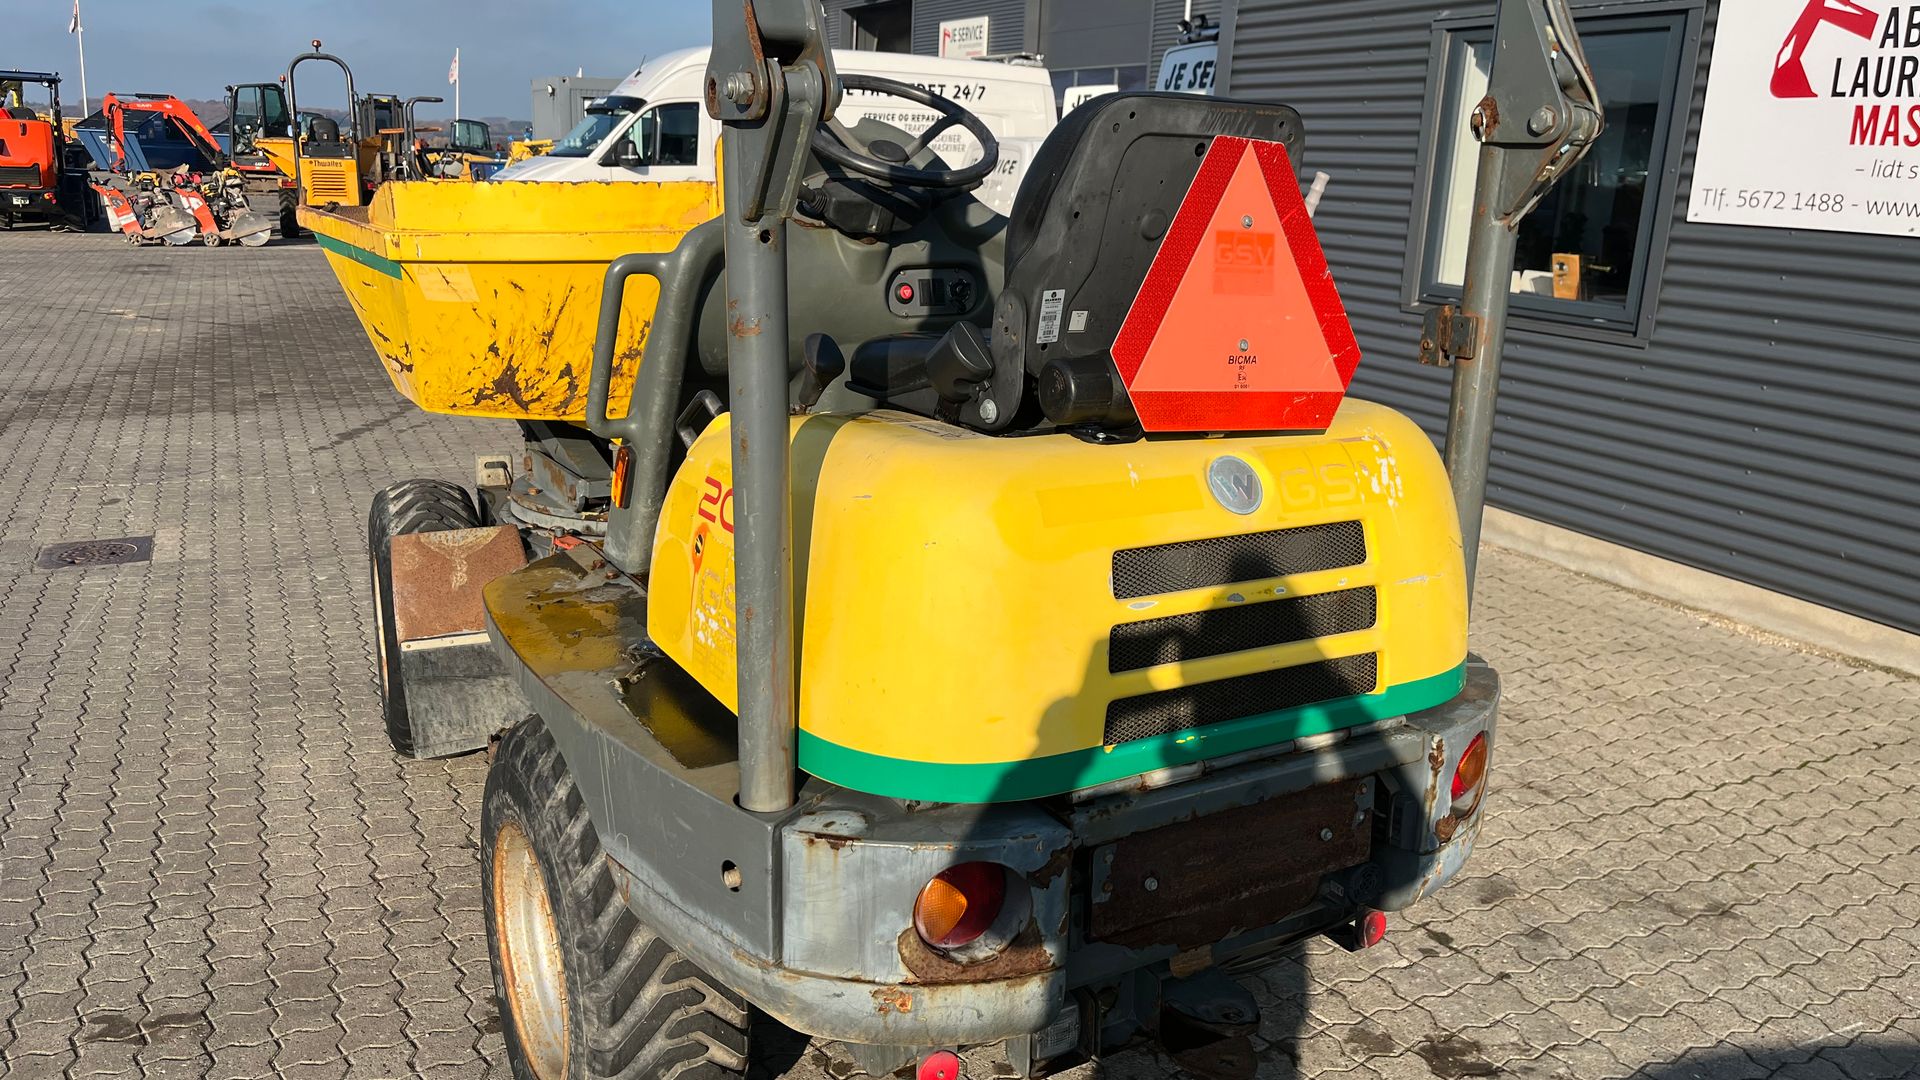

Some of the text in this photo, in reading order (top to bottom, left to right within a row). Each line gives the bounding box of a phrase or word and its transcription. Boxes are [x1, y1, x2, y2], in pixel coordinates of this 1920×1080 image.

[958, 25, 983, 42] SERVICE
[1879, 5, 1920, 49] AB
[1165, 63, 1187, 90] JE
[1831, 55, 1920, 98] LAUR
[952, 83, 986, 102] 24/7
[898, 113, 909, 122] OG
[1849, 104, 1920, 147] MAS
[1870, 159, 1904, 179] lidt
[1702, 187, 1729, 212] Tlf.
[1736, 189, 1786, 210] 5672
[1791, 192, 1845, 213] 1488
[1228, 355, 1257, 365] BICMA
